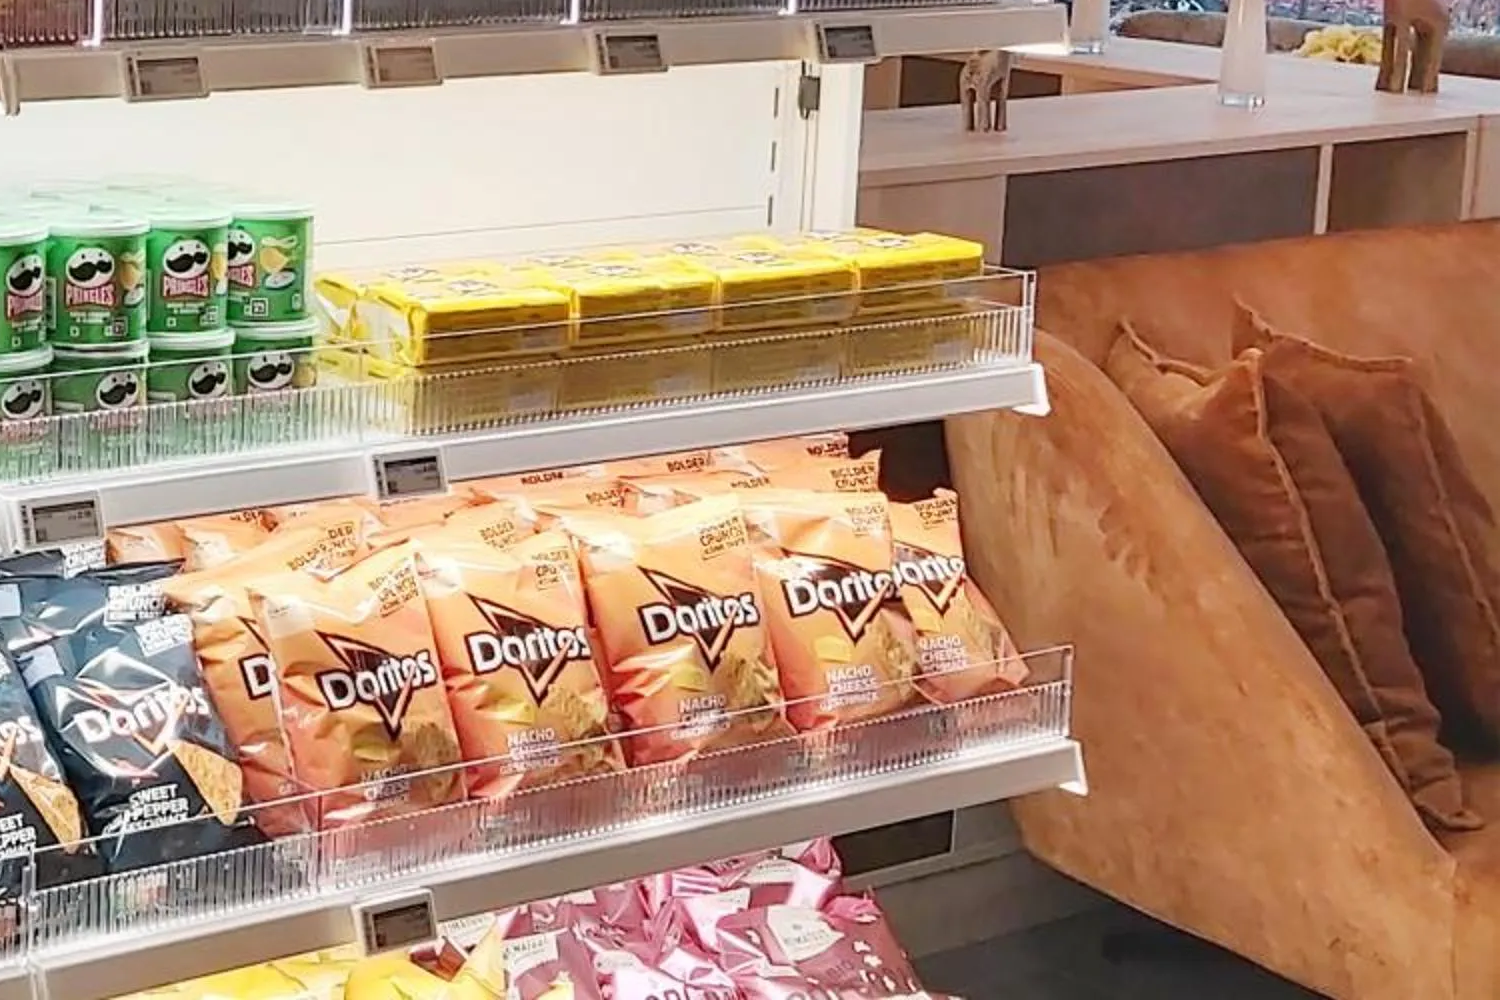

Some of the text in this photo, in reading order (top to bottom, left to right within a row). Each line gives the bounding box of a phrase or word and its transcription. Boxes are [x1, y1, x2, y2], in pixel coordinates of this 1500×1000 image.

[66, 283, 116, 306] PRINGLES
[641, 592, 759, 643] Doritos
[469, 626, 591, 674] Doritos
[319, 650, 437, 709] Doritos
[826, 664, 872, 683] NACHO
[508, 727, 555, 748] NACHO
[128, 784, 179, 805] SWEET
